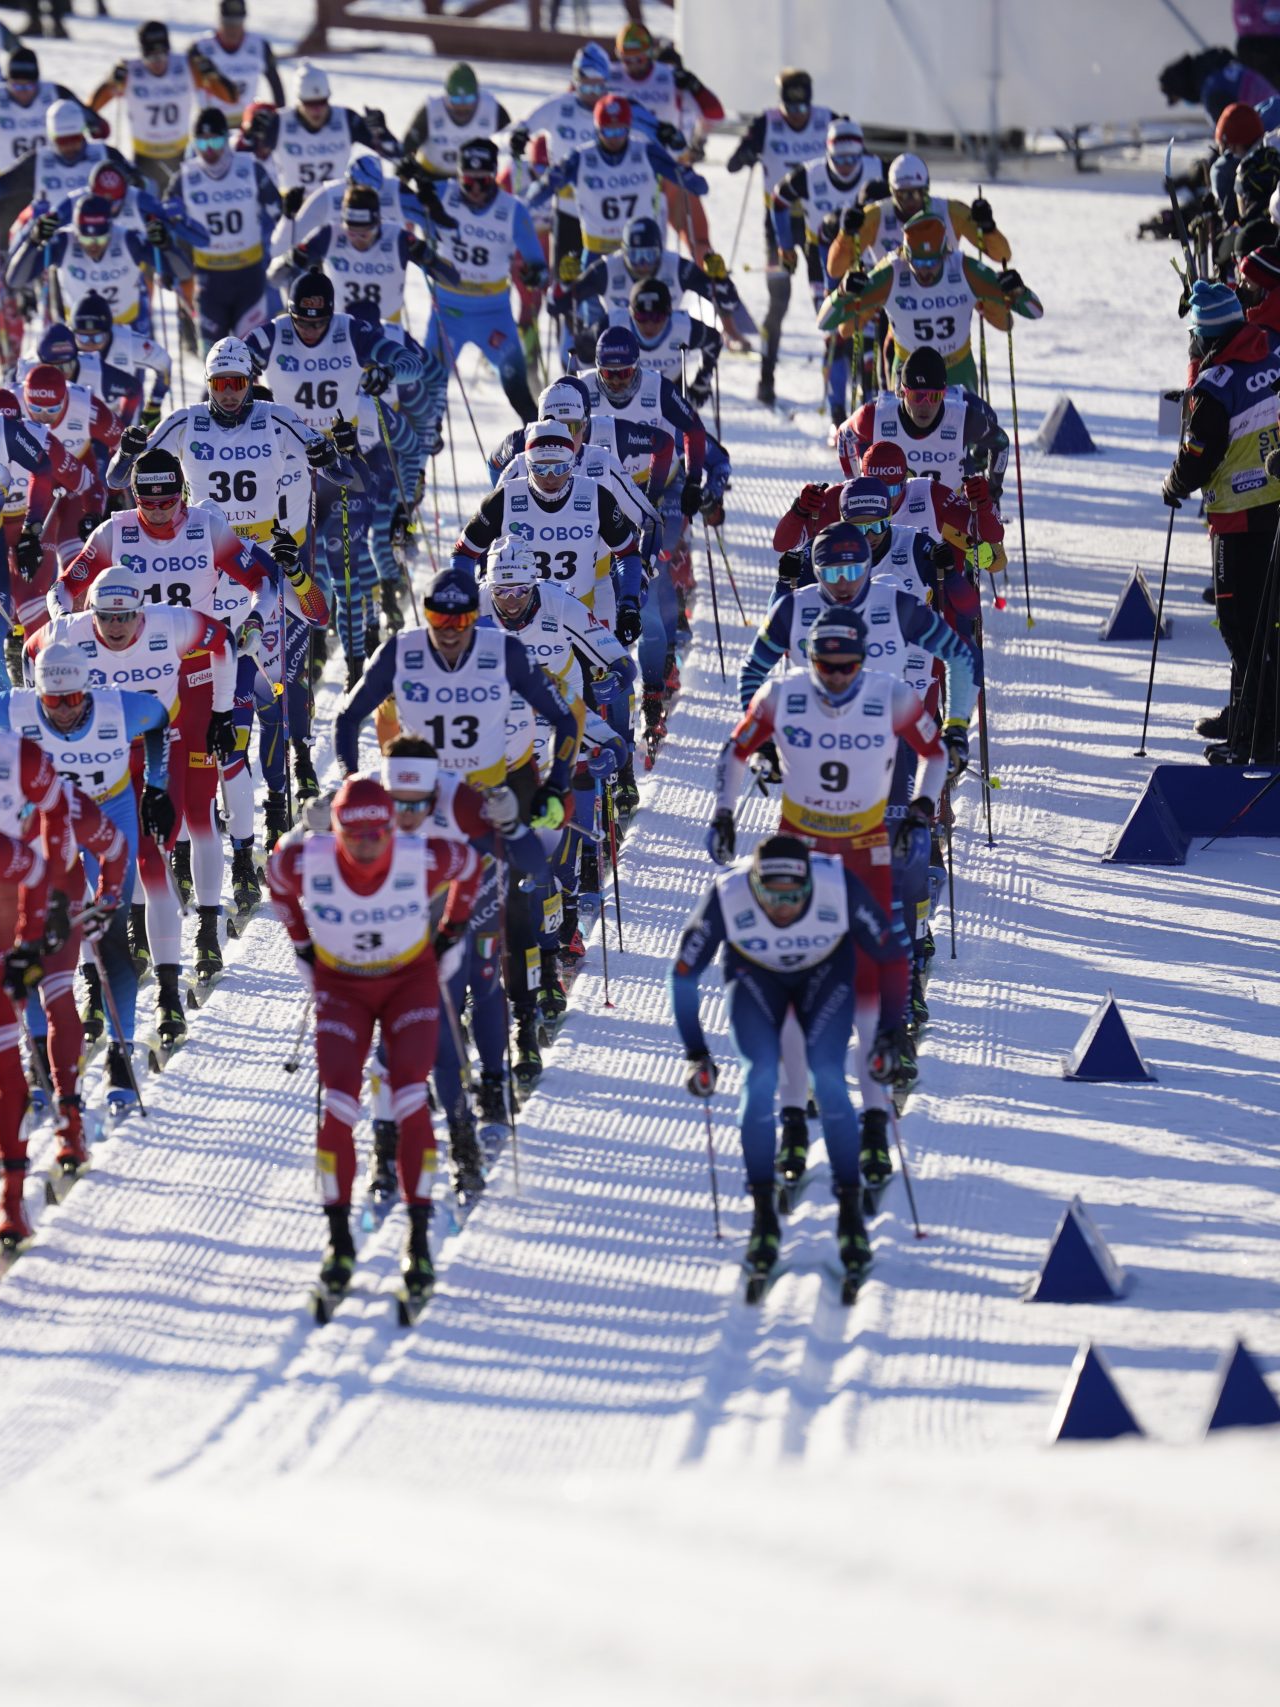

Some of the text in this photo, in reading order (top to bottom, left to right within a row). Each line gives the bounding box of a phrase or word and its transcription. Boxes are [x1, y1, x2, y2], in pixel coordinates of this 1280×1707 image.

[145, 104, 180, 126] 70
[298, 163, 335, 184] 52
[607, 173, 650, 189] OBOS
[211, 188, 254, 203] OBOS
[601, 196, 642, 220] 67
[206, 210, 244, 236] 50
[353, 262, 395, 275] OBOS
[344, 282, 382, 304] 38
[921, 294, 969, 311] OBOS
[912, 316, 957, 342] 53
[304, 355, 352, 372] OBOS
[294, 380, 339, 410] 46
[218, 443, 272, 462] OBOS
[907, 450, 957, 464] OBOS
[137, 473, 169, 483] SpareBank
[866, 465, 902, 476] LUKOIL
[207, 470, 258, 503] 36
[1236, 480, 1263, 493] coop
[574, 502, 591, 510] coop
[848, 497, 880, 506] helvetia
[187, 531, 204, 539] coop
[539, 525, 593, 541] OBOS
[152, 555, 208, 573] OBOS
[1217, 540, 1225, 582] Andorra
[143, 583, 192, 608] 18
[213, 597, 249, 611] BOS
[113, 663, 174, 685] OBOS
[435, 684, 502, 704] OBOS
[424, 715, 480, 750] 13
[819, 733, 885, 750] OBOS
[61, 748, 124, 764] OBOS
[820, 761, 849, 793] 9
[350, 901, 420, 925] OBOS
[353, 931, 384, 951] 3
